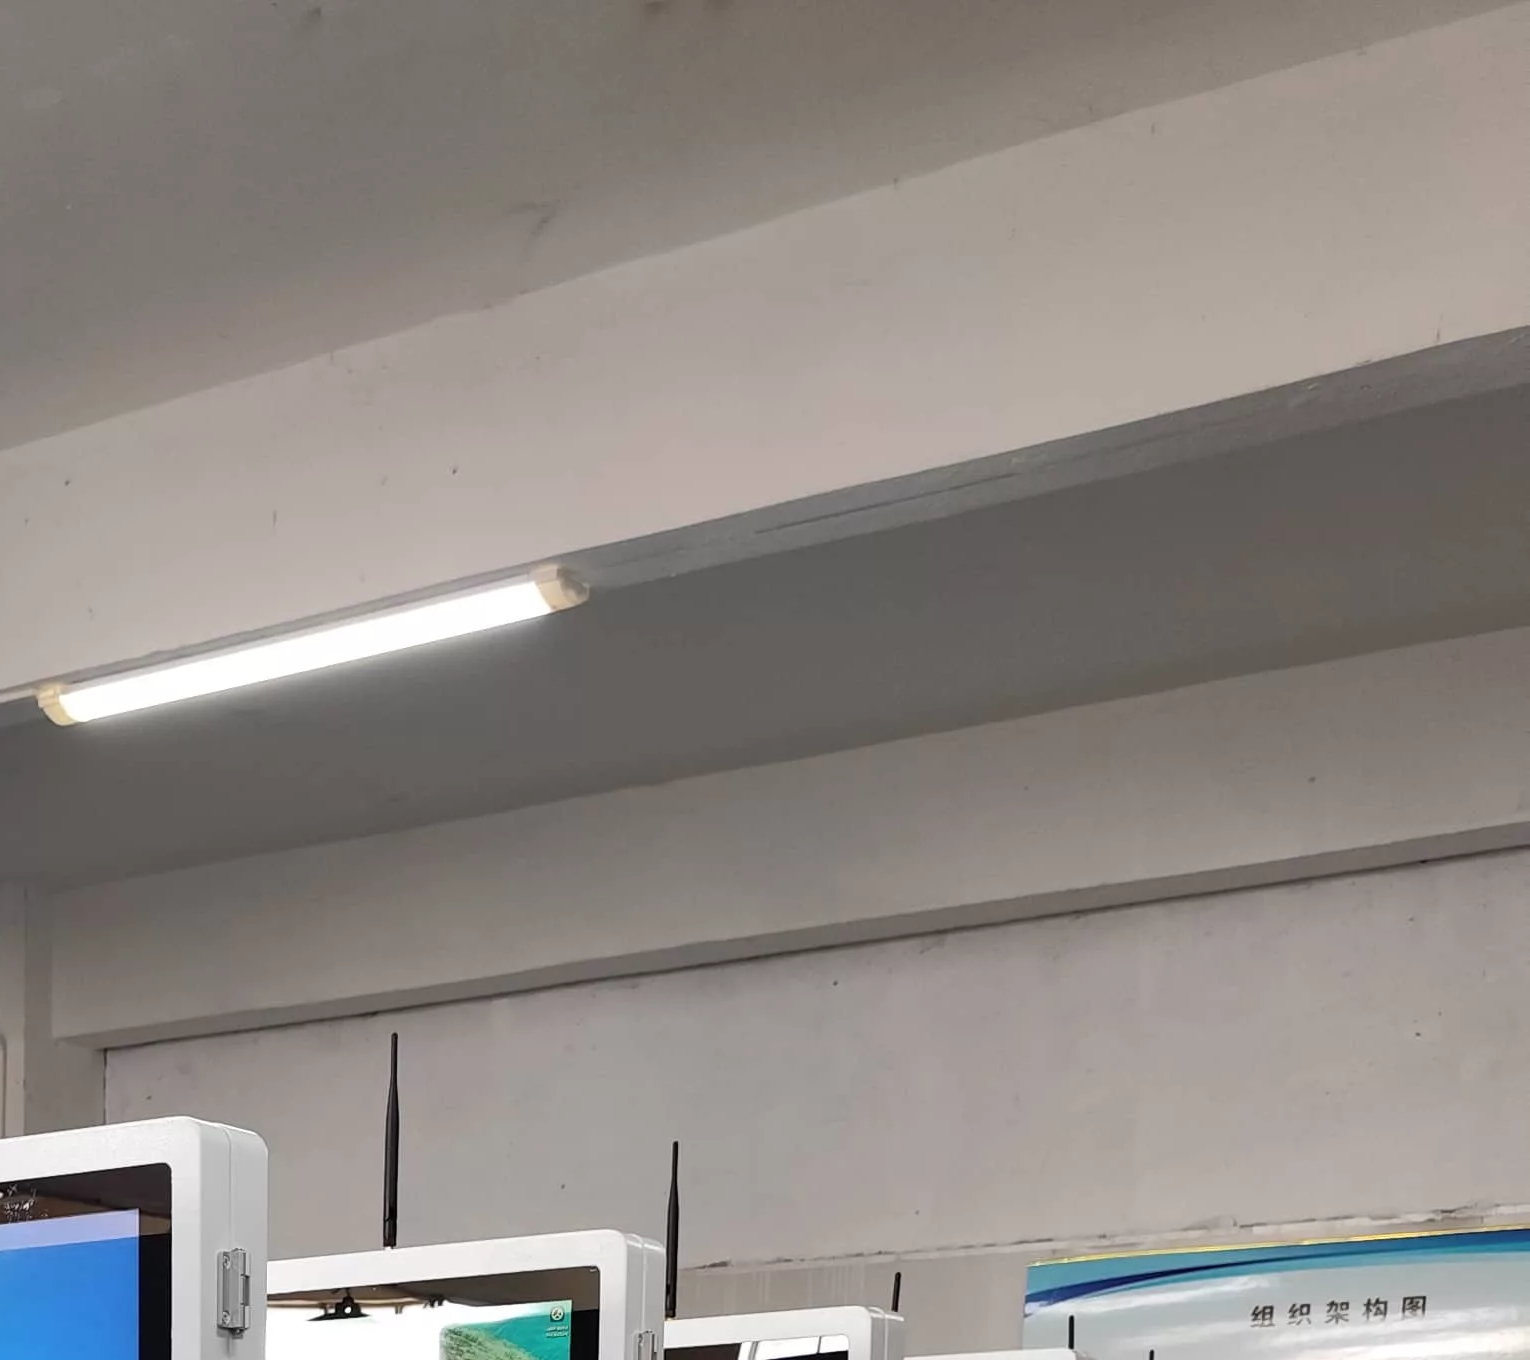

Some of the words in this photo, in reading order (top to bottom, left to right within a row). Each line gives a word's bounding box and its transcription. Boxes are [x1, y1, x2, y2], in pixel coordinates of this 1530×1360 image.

[1250, 1296, 1427, 1327] 组织架构图
